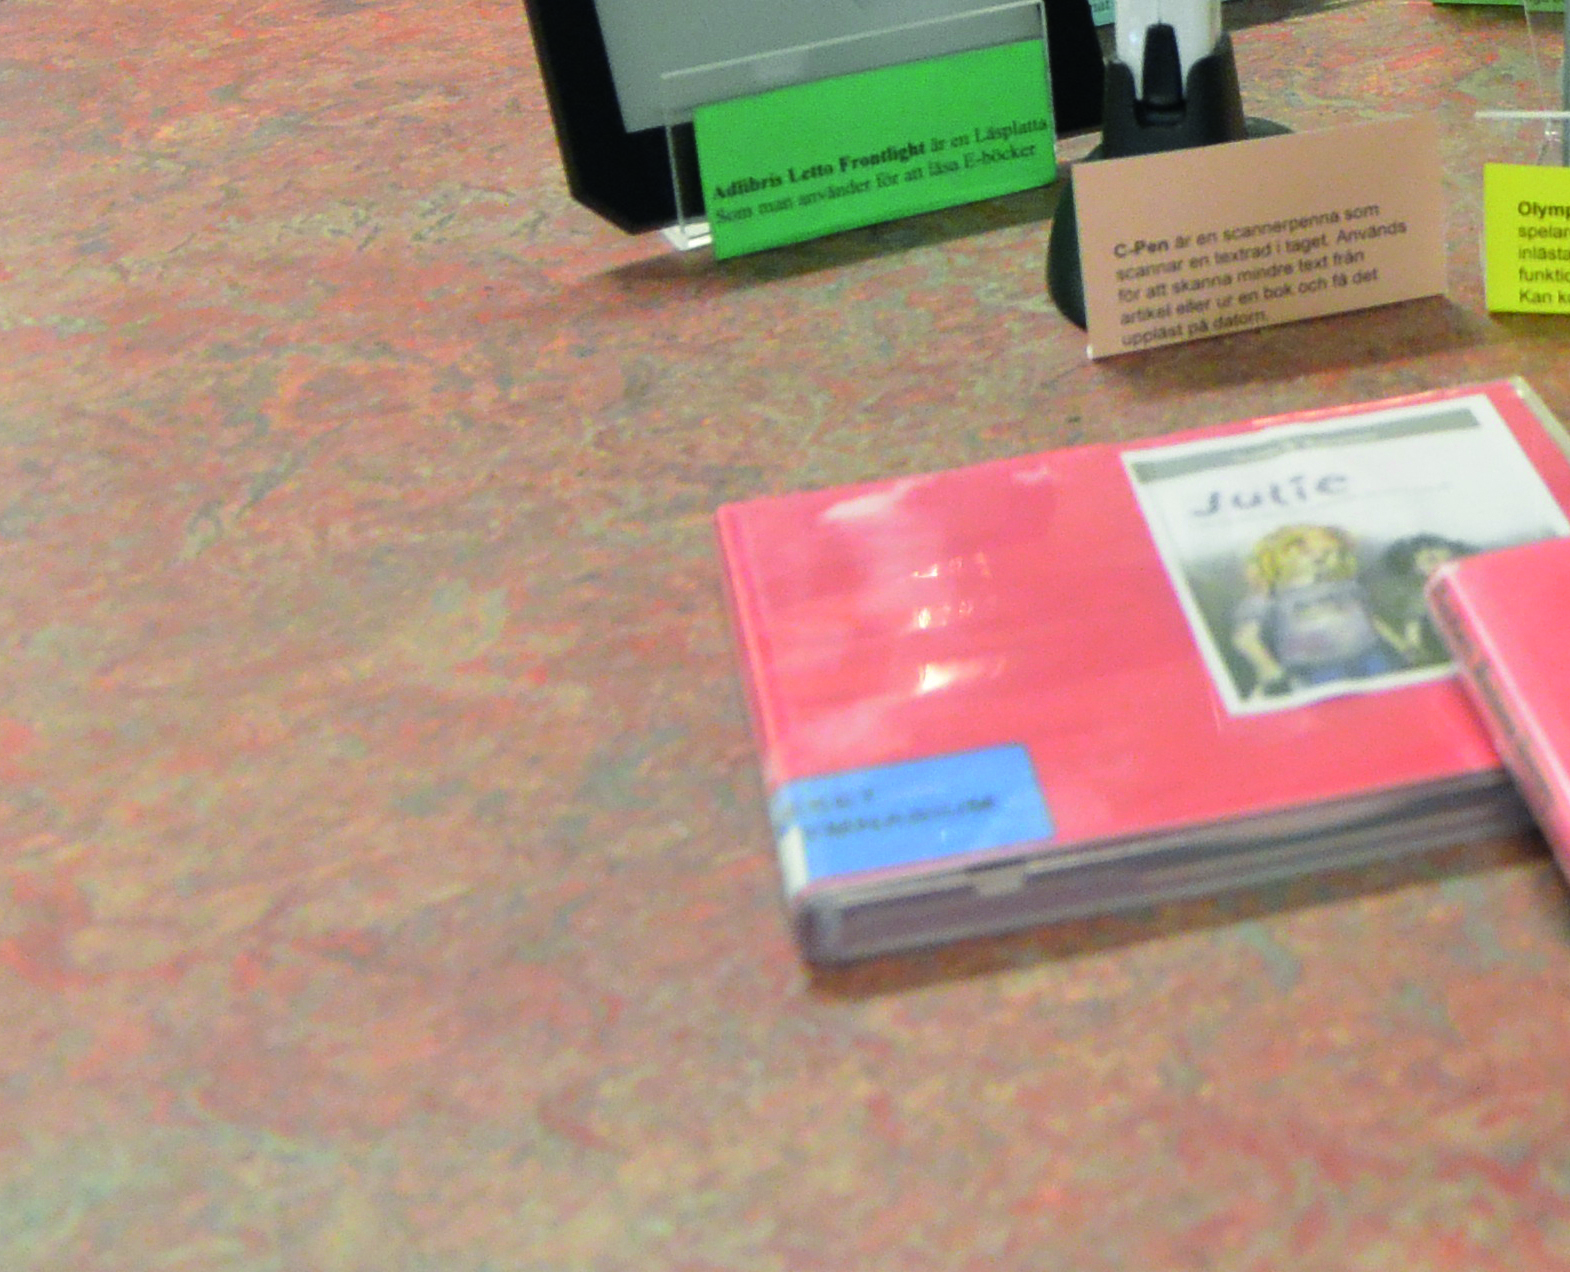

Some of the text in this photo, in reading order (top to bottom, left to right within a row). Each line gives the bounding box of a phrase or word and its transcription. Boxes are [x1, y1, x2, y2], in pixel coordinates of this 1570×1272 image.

[713, 174, 783, 199] Adlibris
[787, 163, 834, 183] Letto
[838, 140, 925, 174] Frontlight
[930, 137, 945, 153] är
[950, 135, 970, 148] en
[758, 197, 793, 215] man
[876, 171, 899, 189] för
[904, 166, 924, 182] att
[963, 143, 1036, 169] E-böcker
[1114, 204, 1380, 258] C-Pen är en scannerpenna som
[1116, 258, 1183, 281] scannar
[1188, 254, 1210, 269] en
[1214, 241, 1272, 264] textrad
[1117, 247, 1365, 303] för att skanna mindre text från
[1120, 267, 1378, 325] artikel eller ur en bok och få det
[1518, 288, 1552, 304] Kan
[1121, 317, 1209, 347] uppläst på
[1193, 471, 1354, 518] Julie
